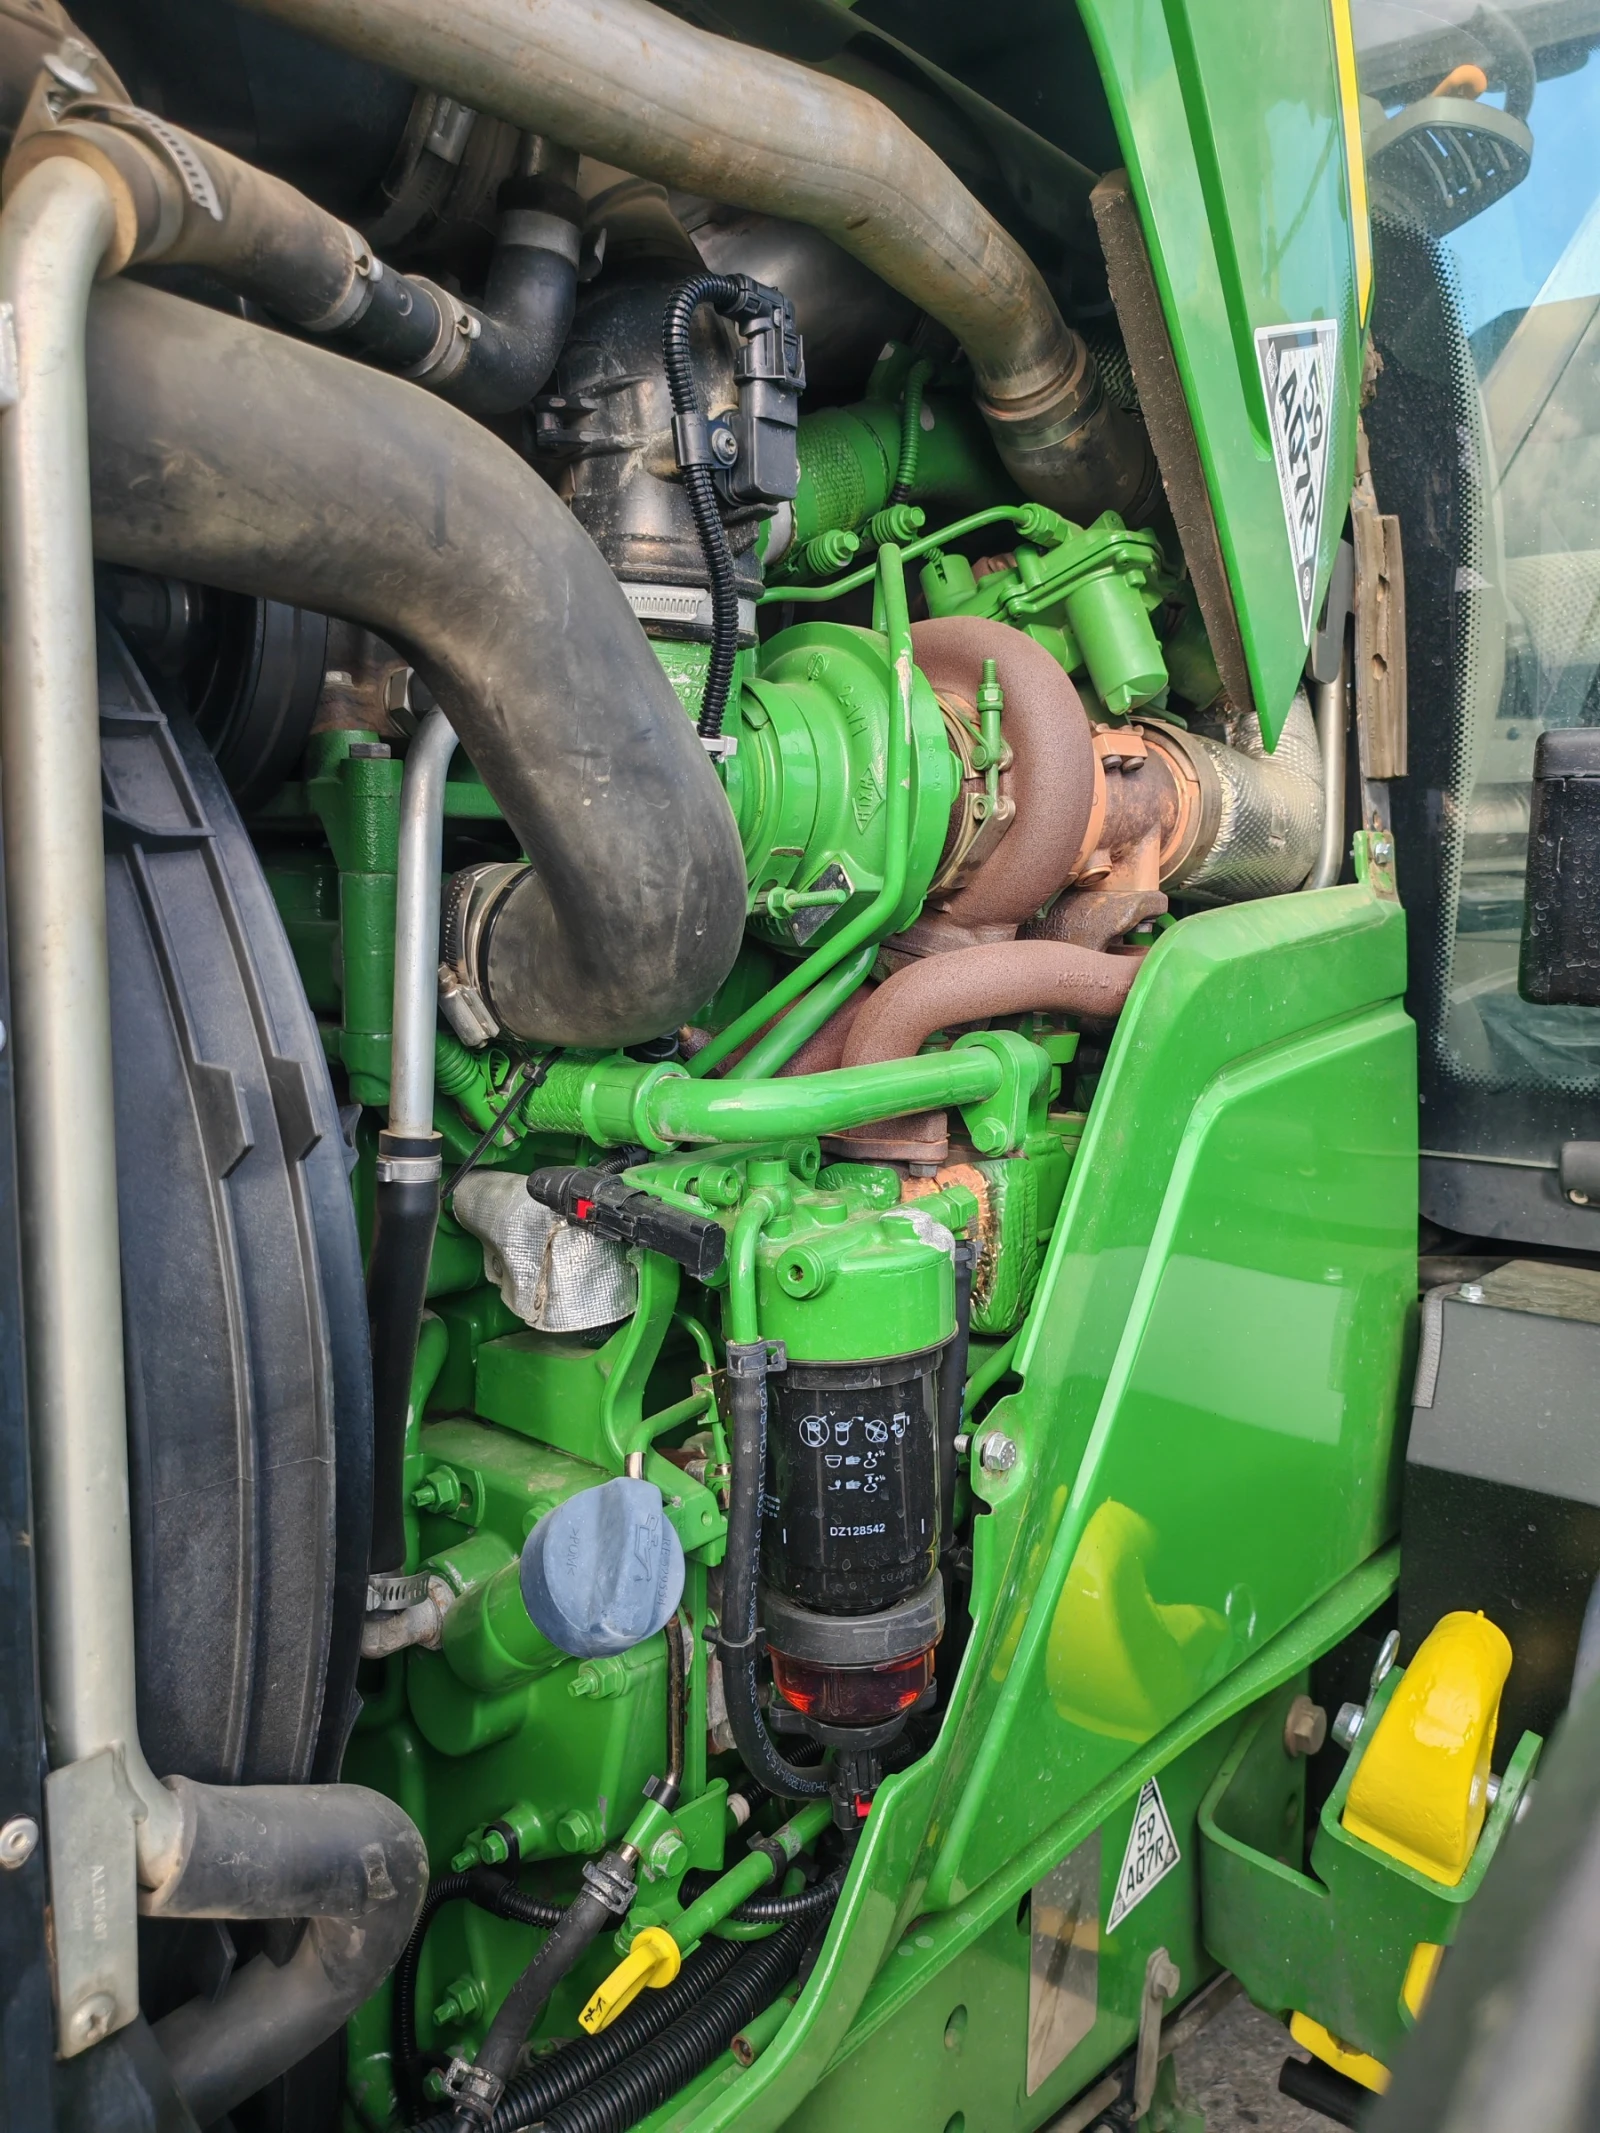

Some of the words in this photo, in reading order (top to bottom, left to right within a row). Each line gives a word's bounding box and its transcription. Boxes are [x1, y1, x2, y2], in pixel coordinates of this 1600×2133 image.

[1304, 357, 1324, 451] 59
[1278, 370, 1317, 555] AQ7R
[829, 1523, 886, 1537] DZ128542
[1137, 1812, 1156, 1852] 59
[1125, 1834, 1164, 1899] AQ7R
